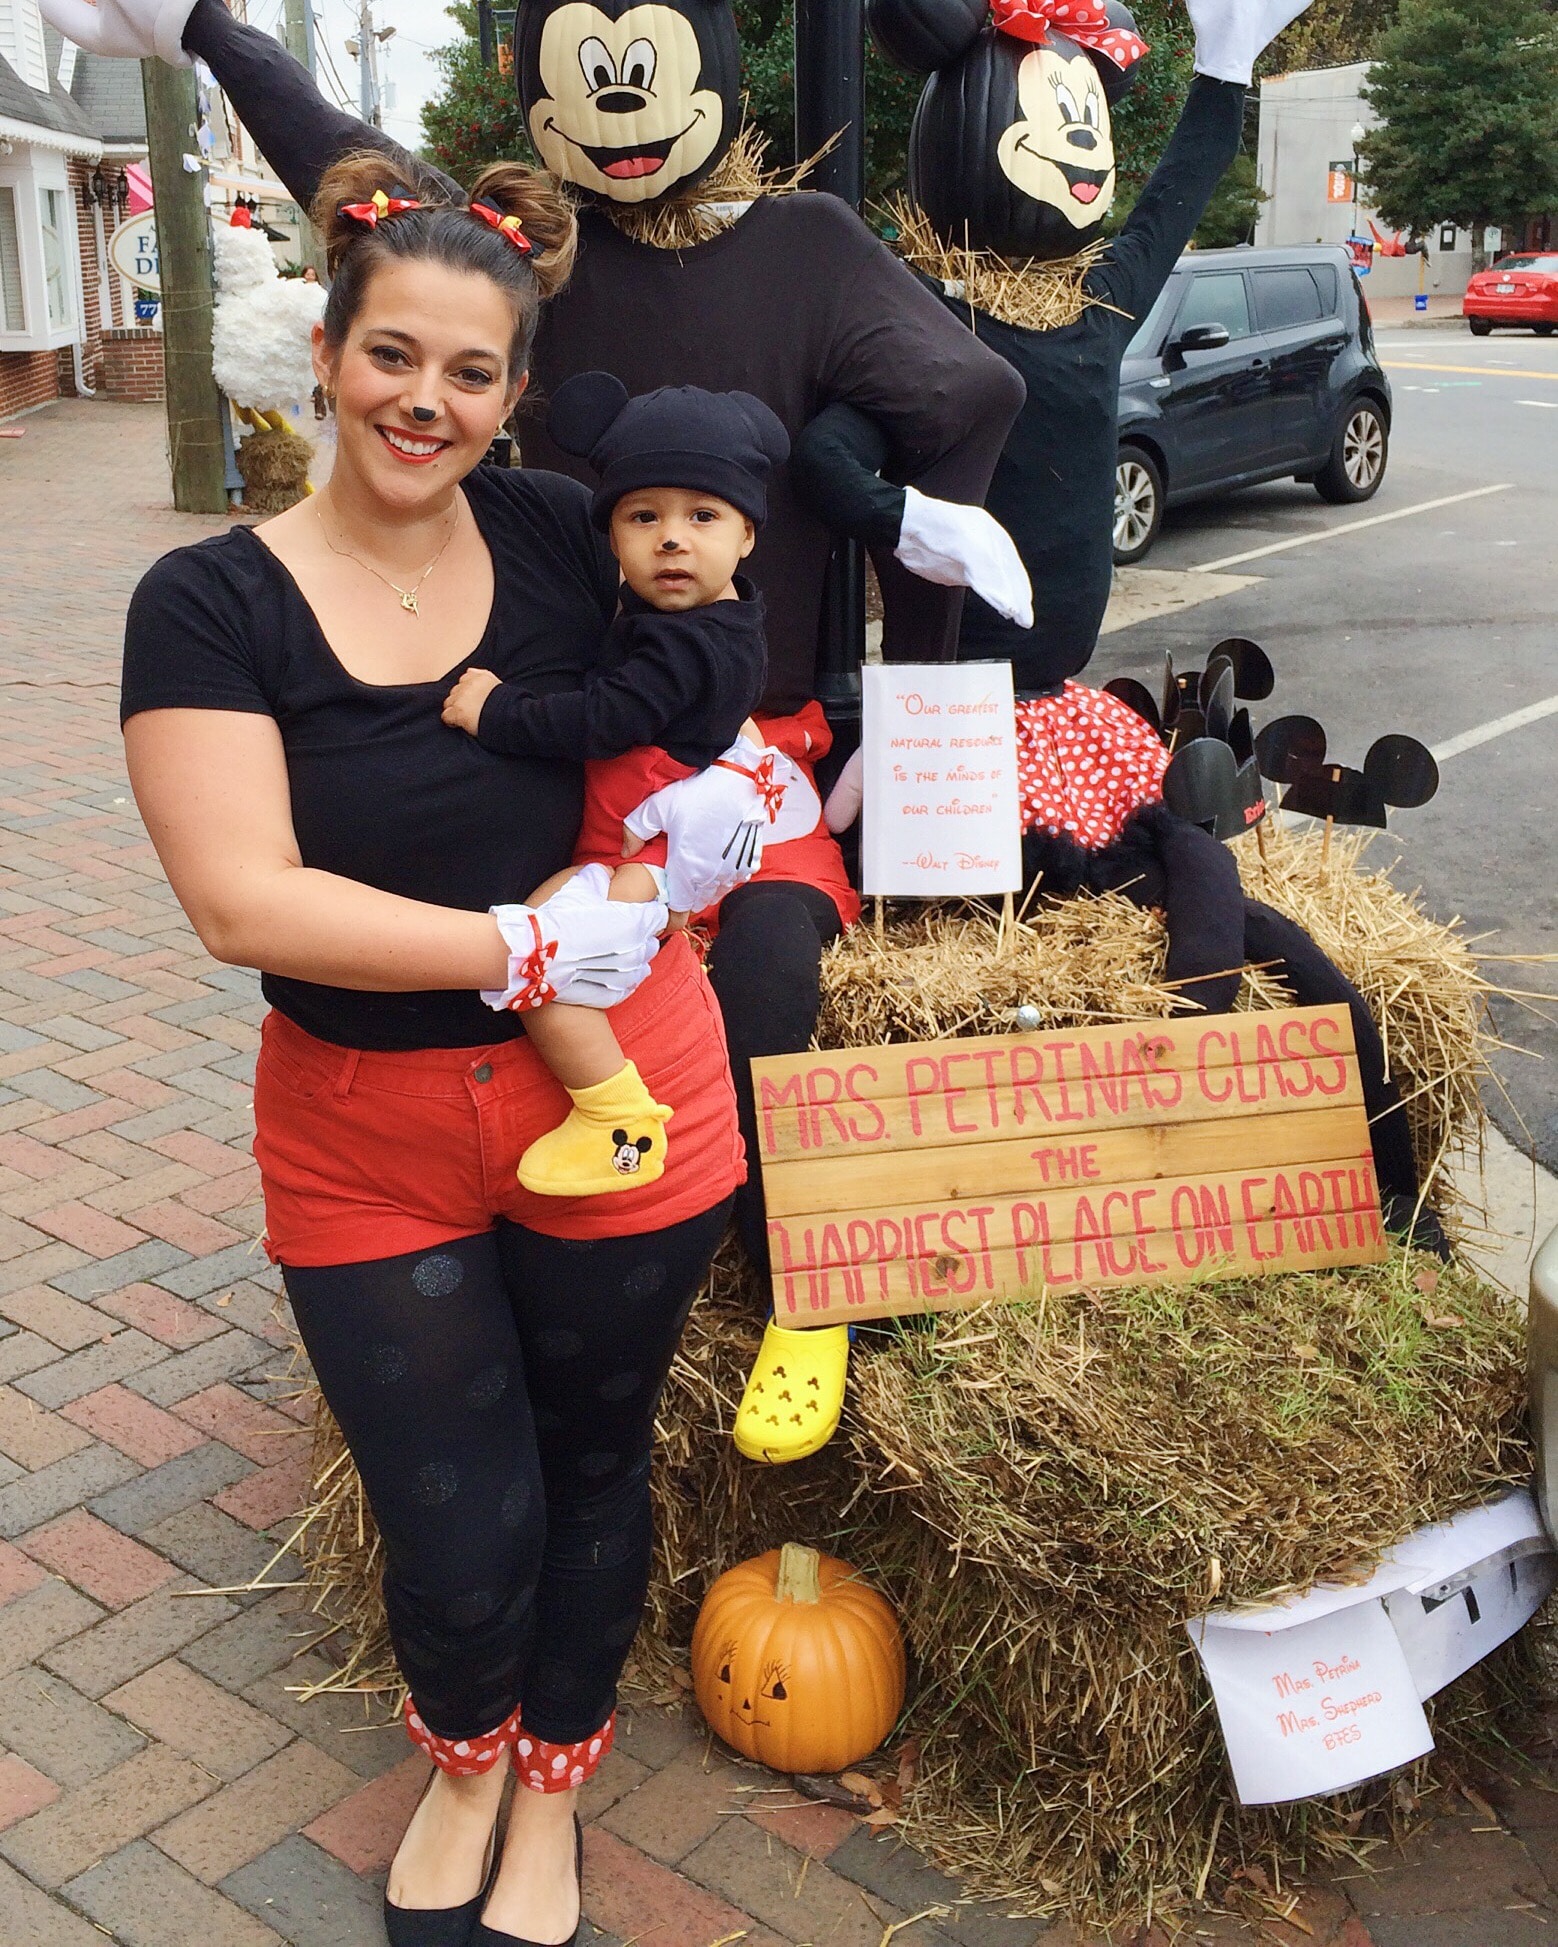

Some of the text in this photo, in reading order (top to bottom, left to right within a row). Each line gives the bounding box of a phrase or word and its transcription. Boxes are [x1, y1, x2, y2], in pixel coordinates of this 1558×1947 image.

[949, 702, 999, 715] GREATEST
[890, 738, 942, 750] NATURAL
[893, 765, 1002, 783] IS THE MINDS OF
[902, 805, 929, 815] OUR
[760, 1018, 1347, 1155] MRS. PETRINA'S CLASS
[1031, 1144, 1101, 1183] THE
[767, 1150, 1383, 1313] HAPPIEST PLACE ON EARTH
